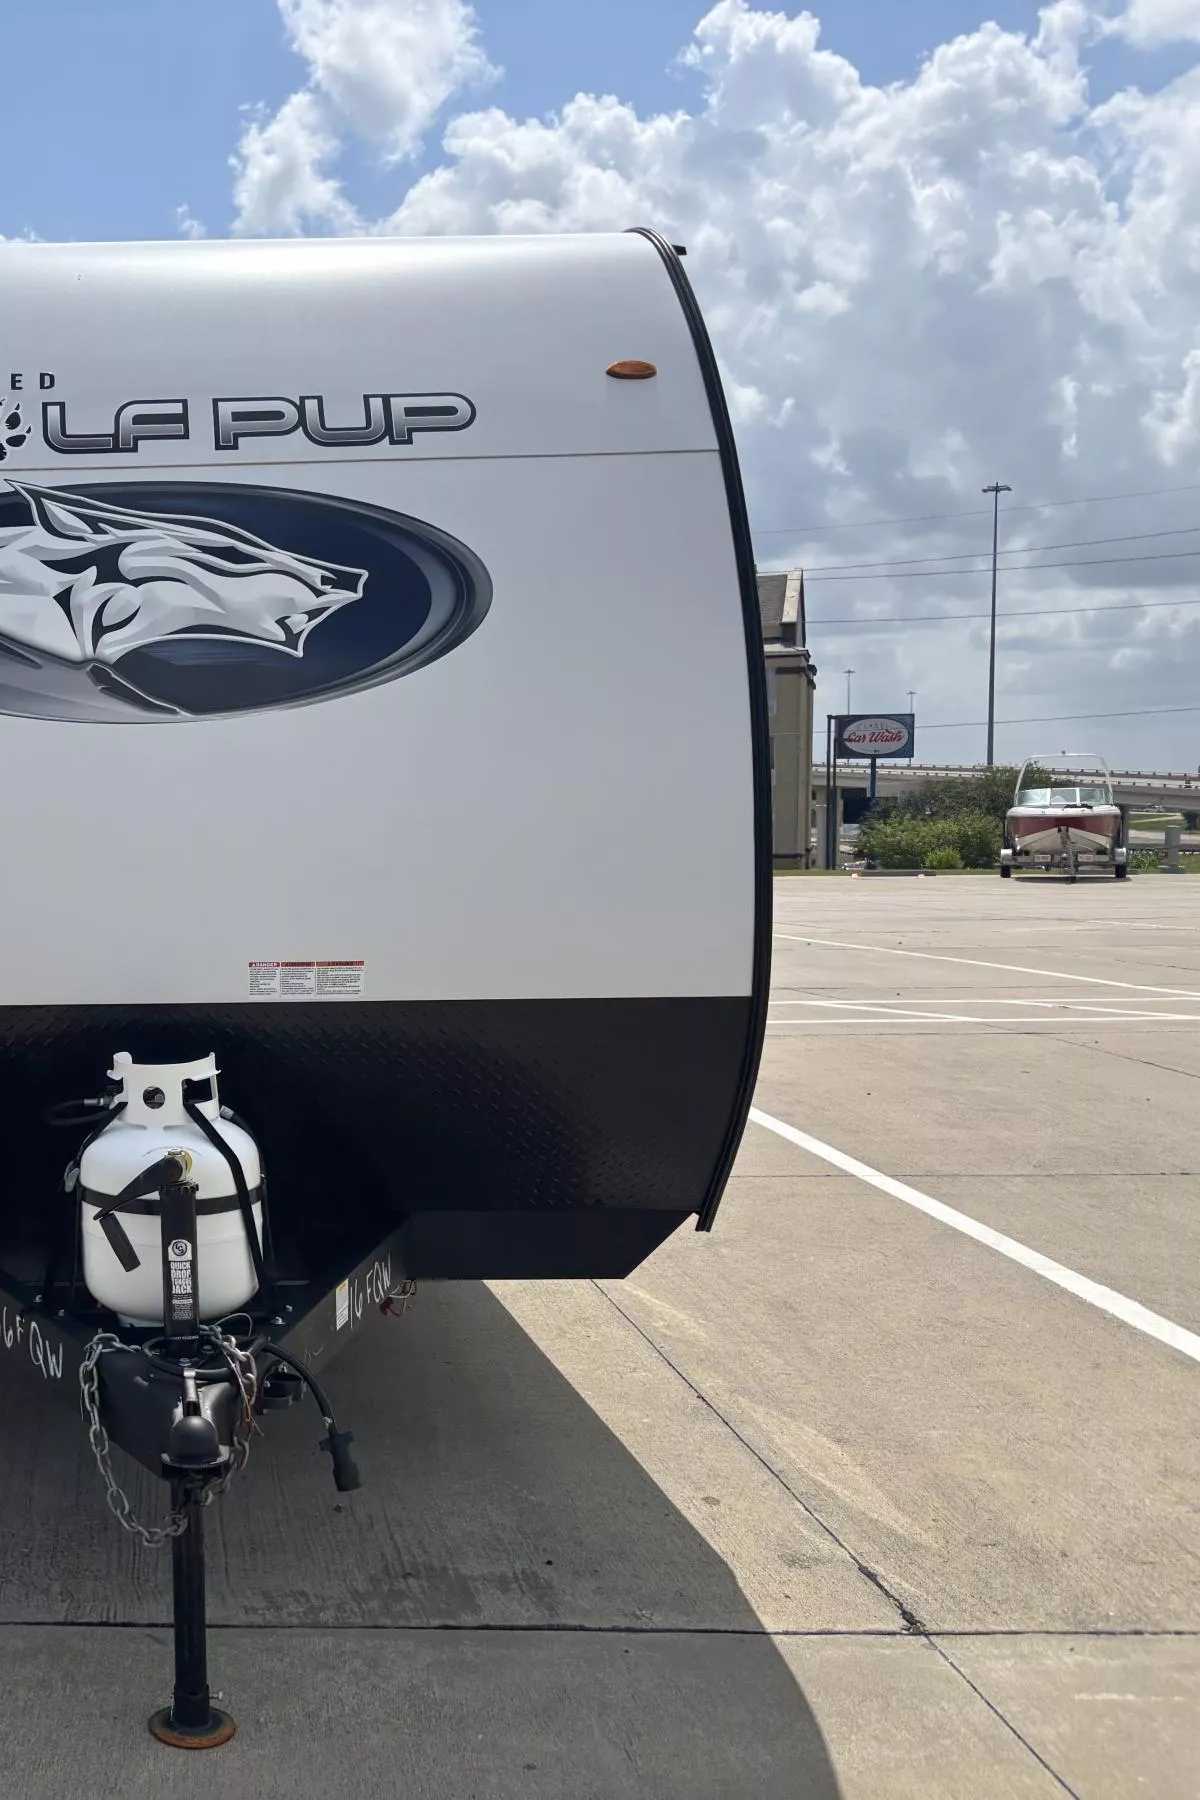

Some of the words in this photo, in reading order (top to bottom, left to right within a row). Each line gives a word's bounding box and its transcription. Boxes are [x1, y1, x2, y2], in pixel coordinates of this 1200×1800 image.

[212, 392, 476, 450] PUP
[843, 731, 866, 743] Car
[869, 729, 904, 743] Wash
[170, 1261, 191, 1270] QUICK
[171, 1269, 192, 1279] DROP
[172, 1285, 193, 1294] JACK
